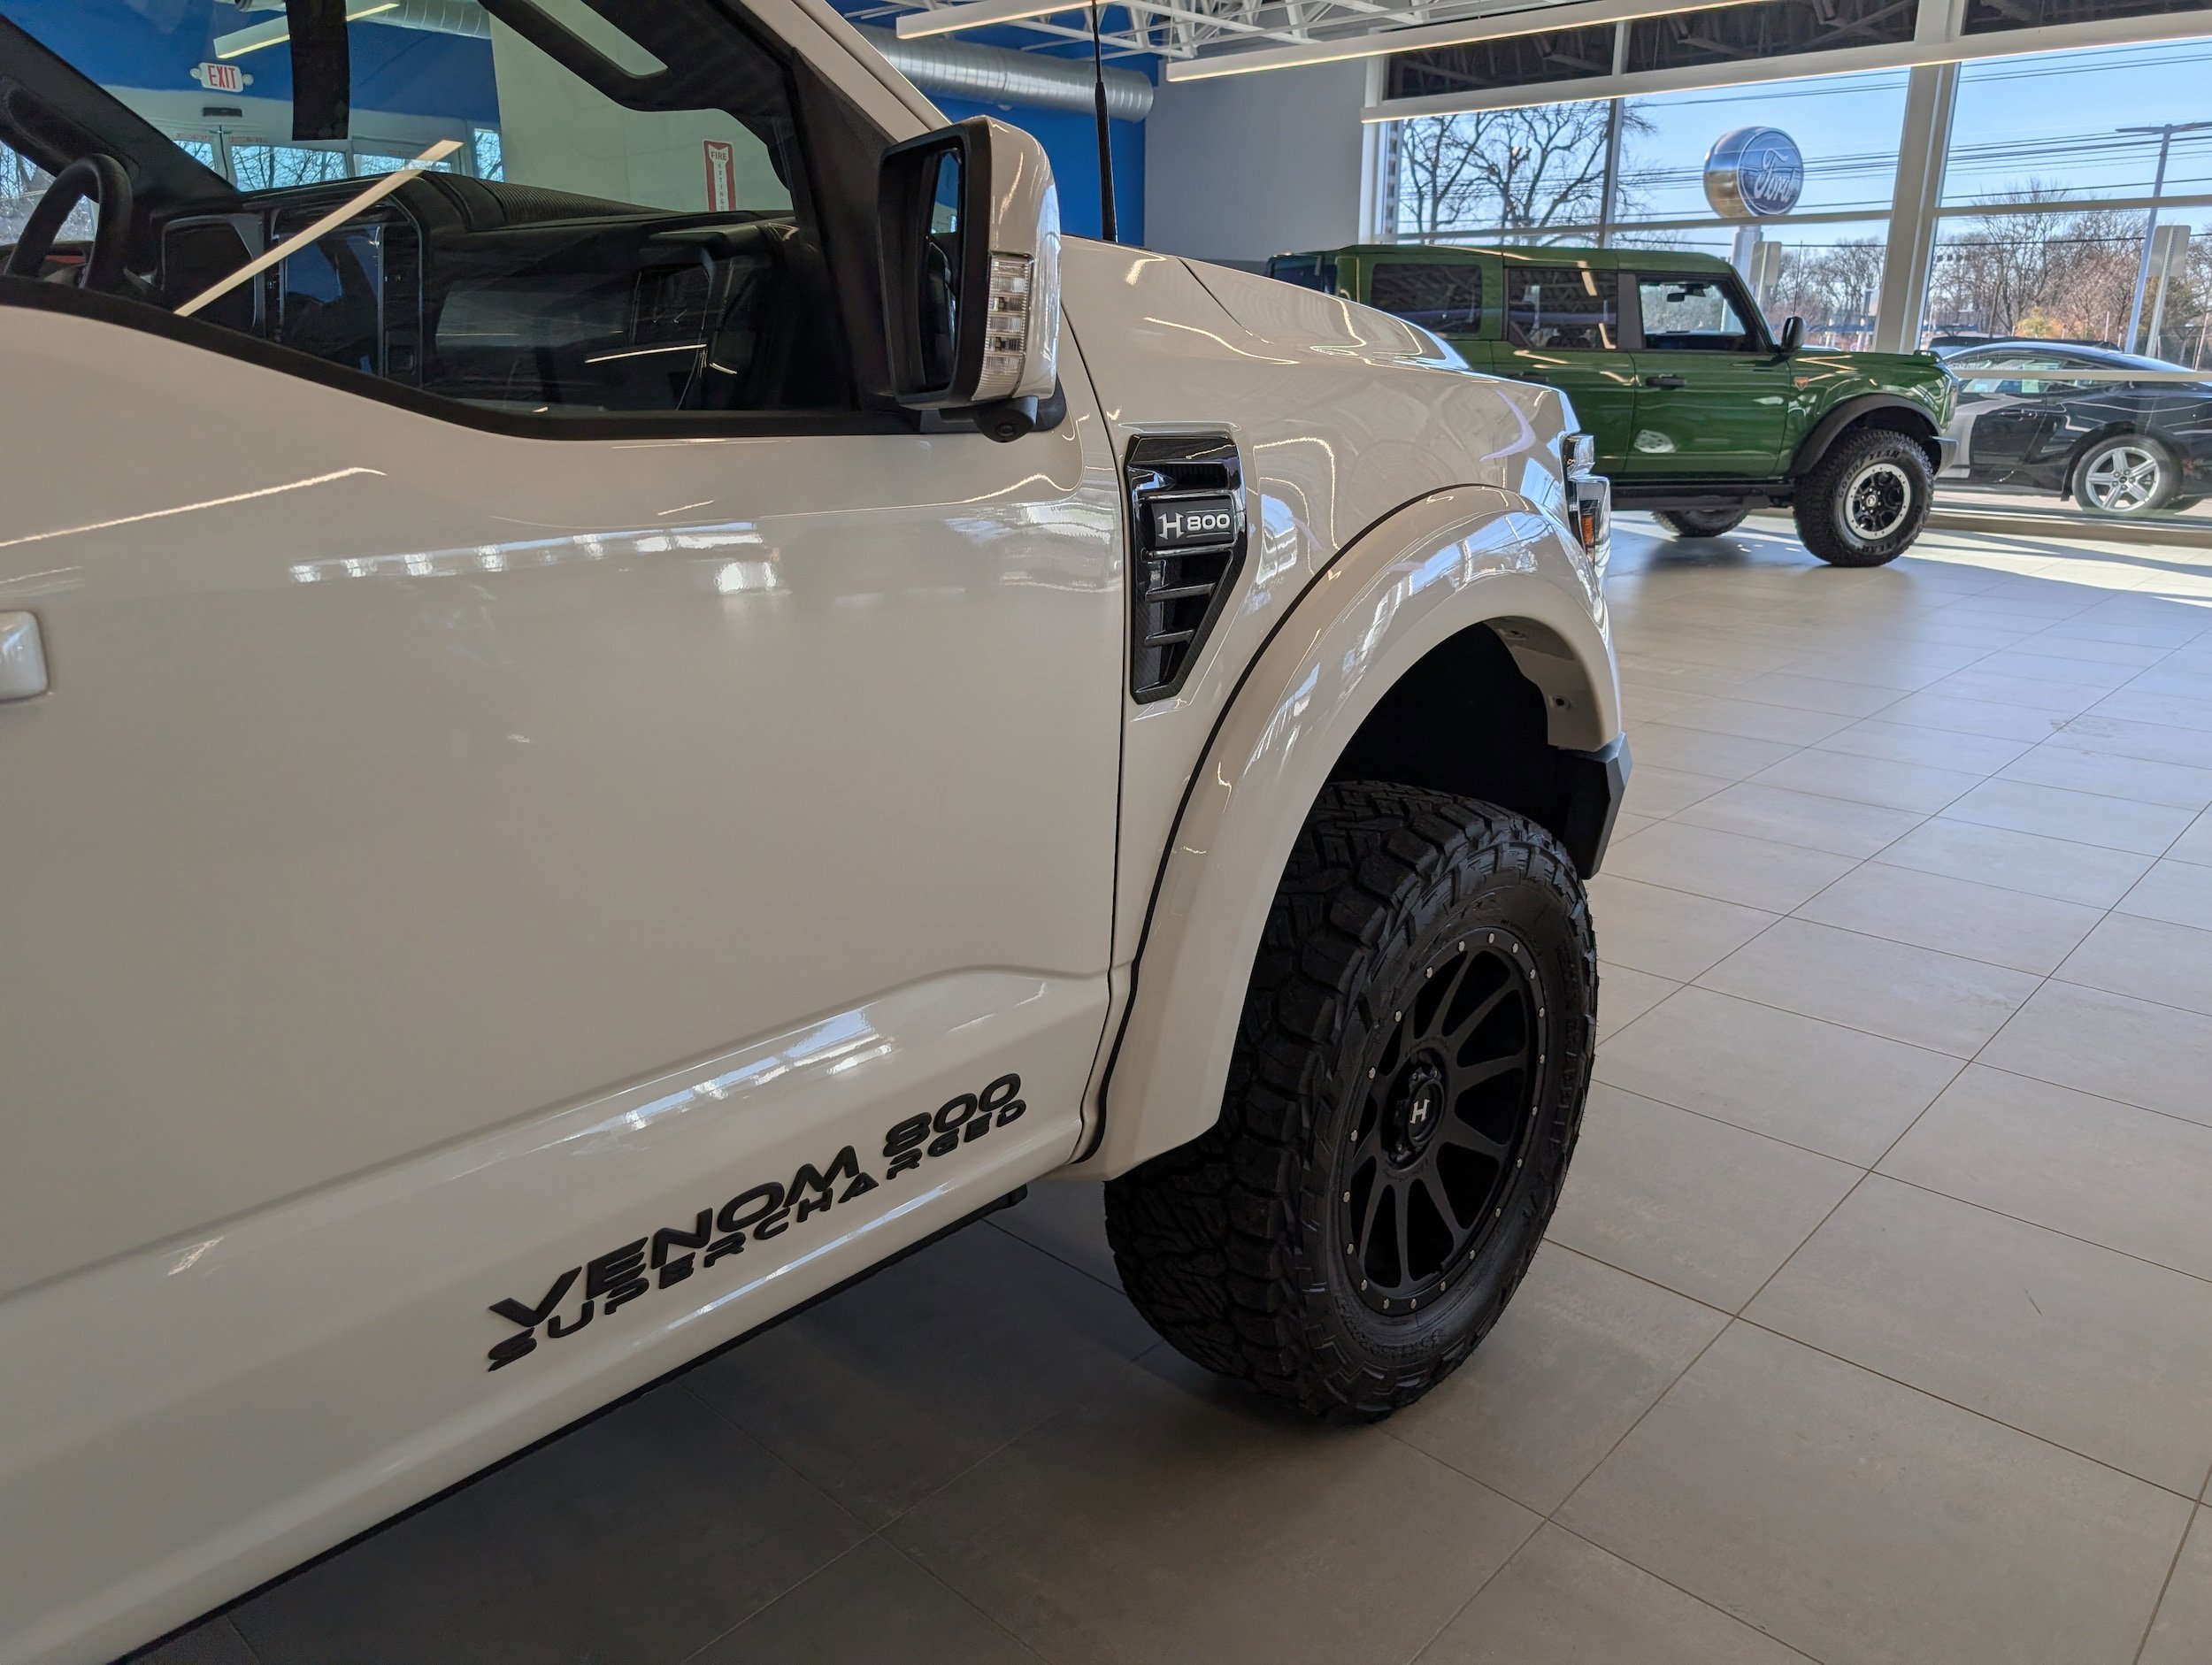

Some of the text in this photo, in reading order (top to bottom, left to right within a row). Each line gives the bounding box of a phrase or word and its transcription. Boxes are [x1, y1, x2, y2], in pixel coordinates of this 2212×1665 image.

[207, 65, 237, 88] EXIT
[710, 151, 727, 160] FIRE
[1754, 149, 1796, 203] Ford
[488, 1073, 1021, 1328] VENOM 800
[488, 1099, 1026, 1372] SUPERCHARGED
